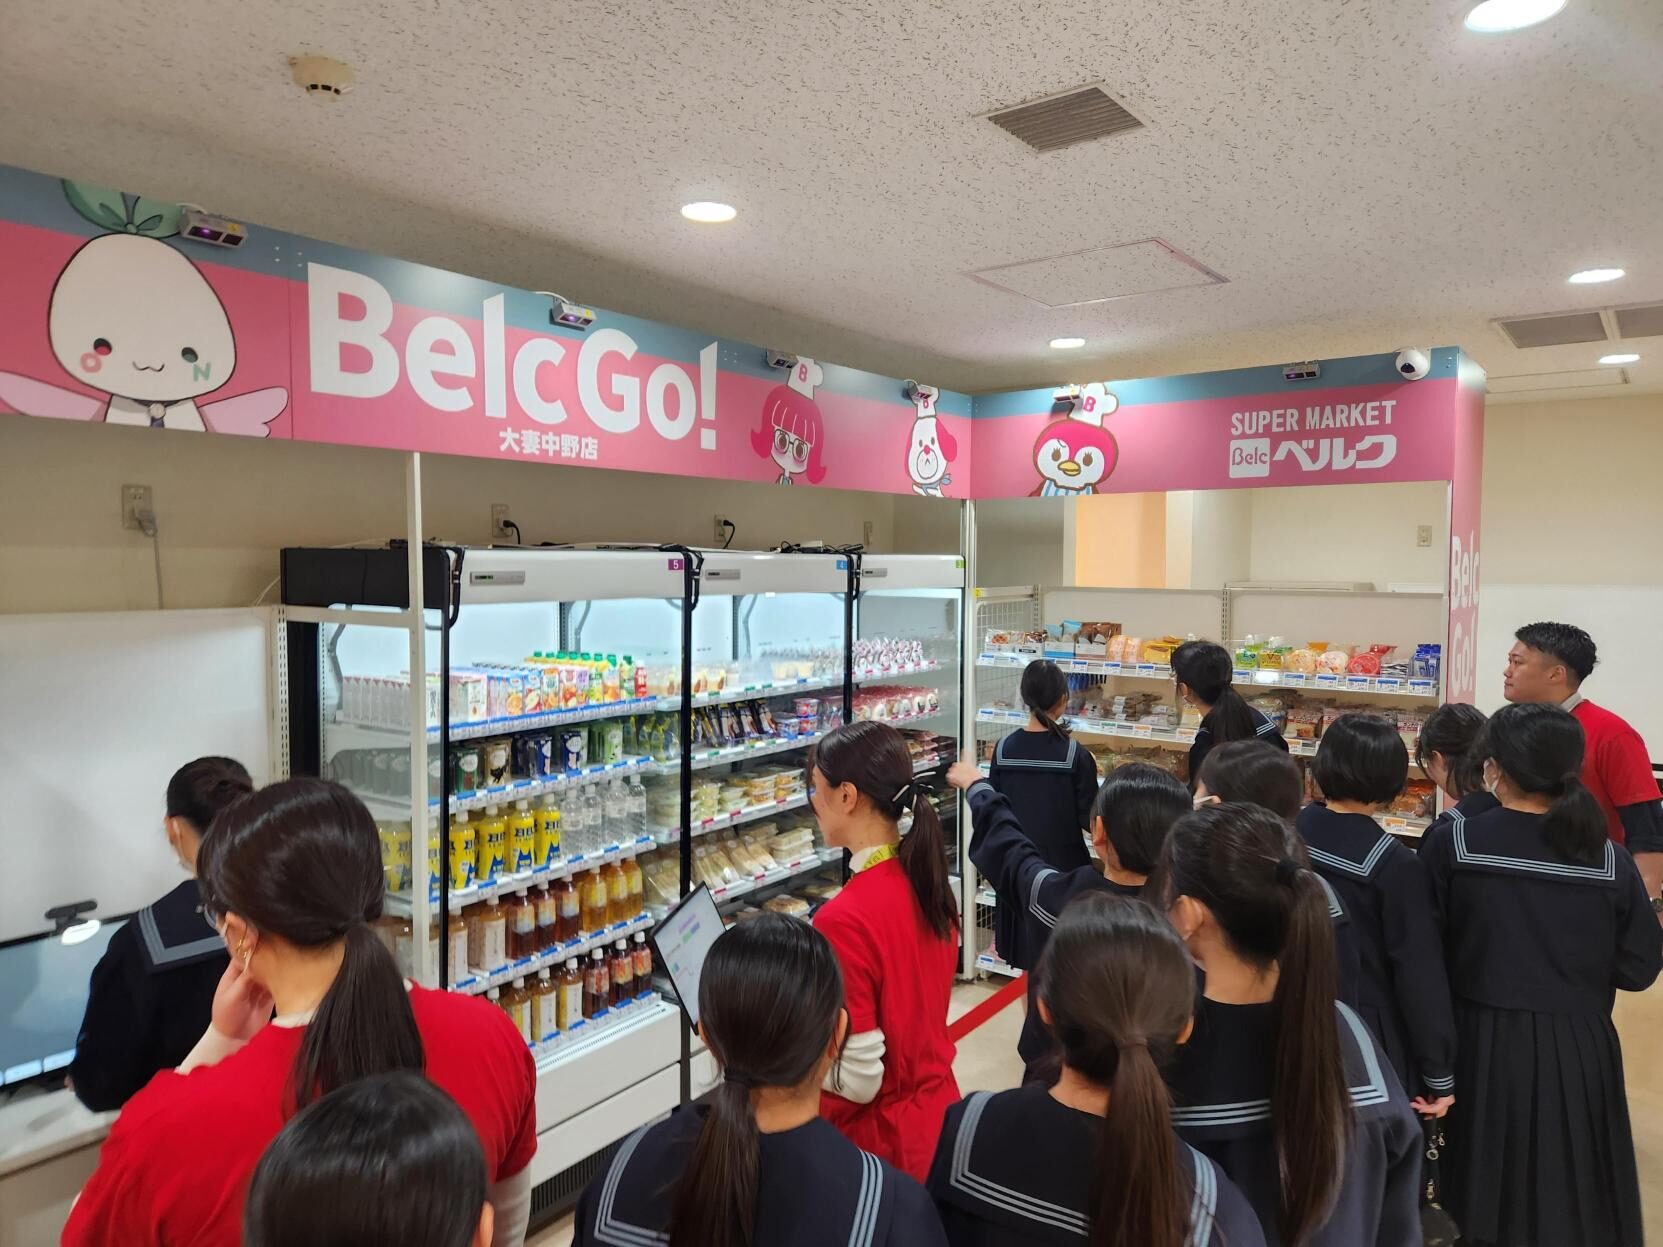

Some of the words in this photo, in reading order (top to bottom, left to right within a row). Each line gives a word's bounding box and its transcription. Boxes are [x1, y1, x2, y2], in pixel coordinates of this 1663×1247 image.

[192, 362, 211, 382] N
[798, 363, 808, 383] B
[1083, 395, 1097, 412] B
[1231, 408, 1299, 435] SUPER
[1305, 400, 1397, 430] MARKET
[499, 427, 598, 460] 大妻中野店
[1231, 446, 1269, 466] Belc
[1272, 434, 1397, 471] ベルク
[673, 559, 679, 570] 5
[1451, 530, 1480, 610] Belc
[1451, 611, 1476, 697] Go!
